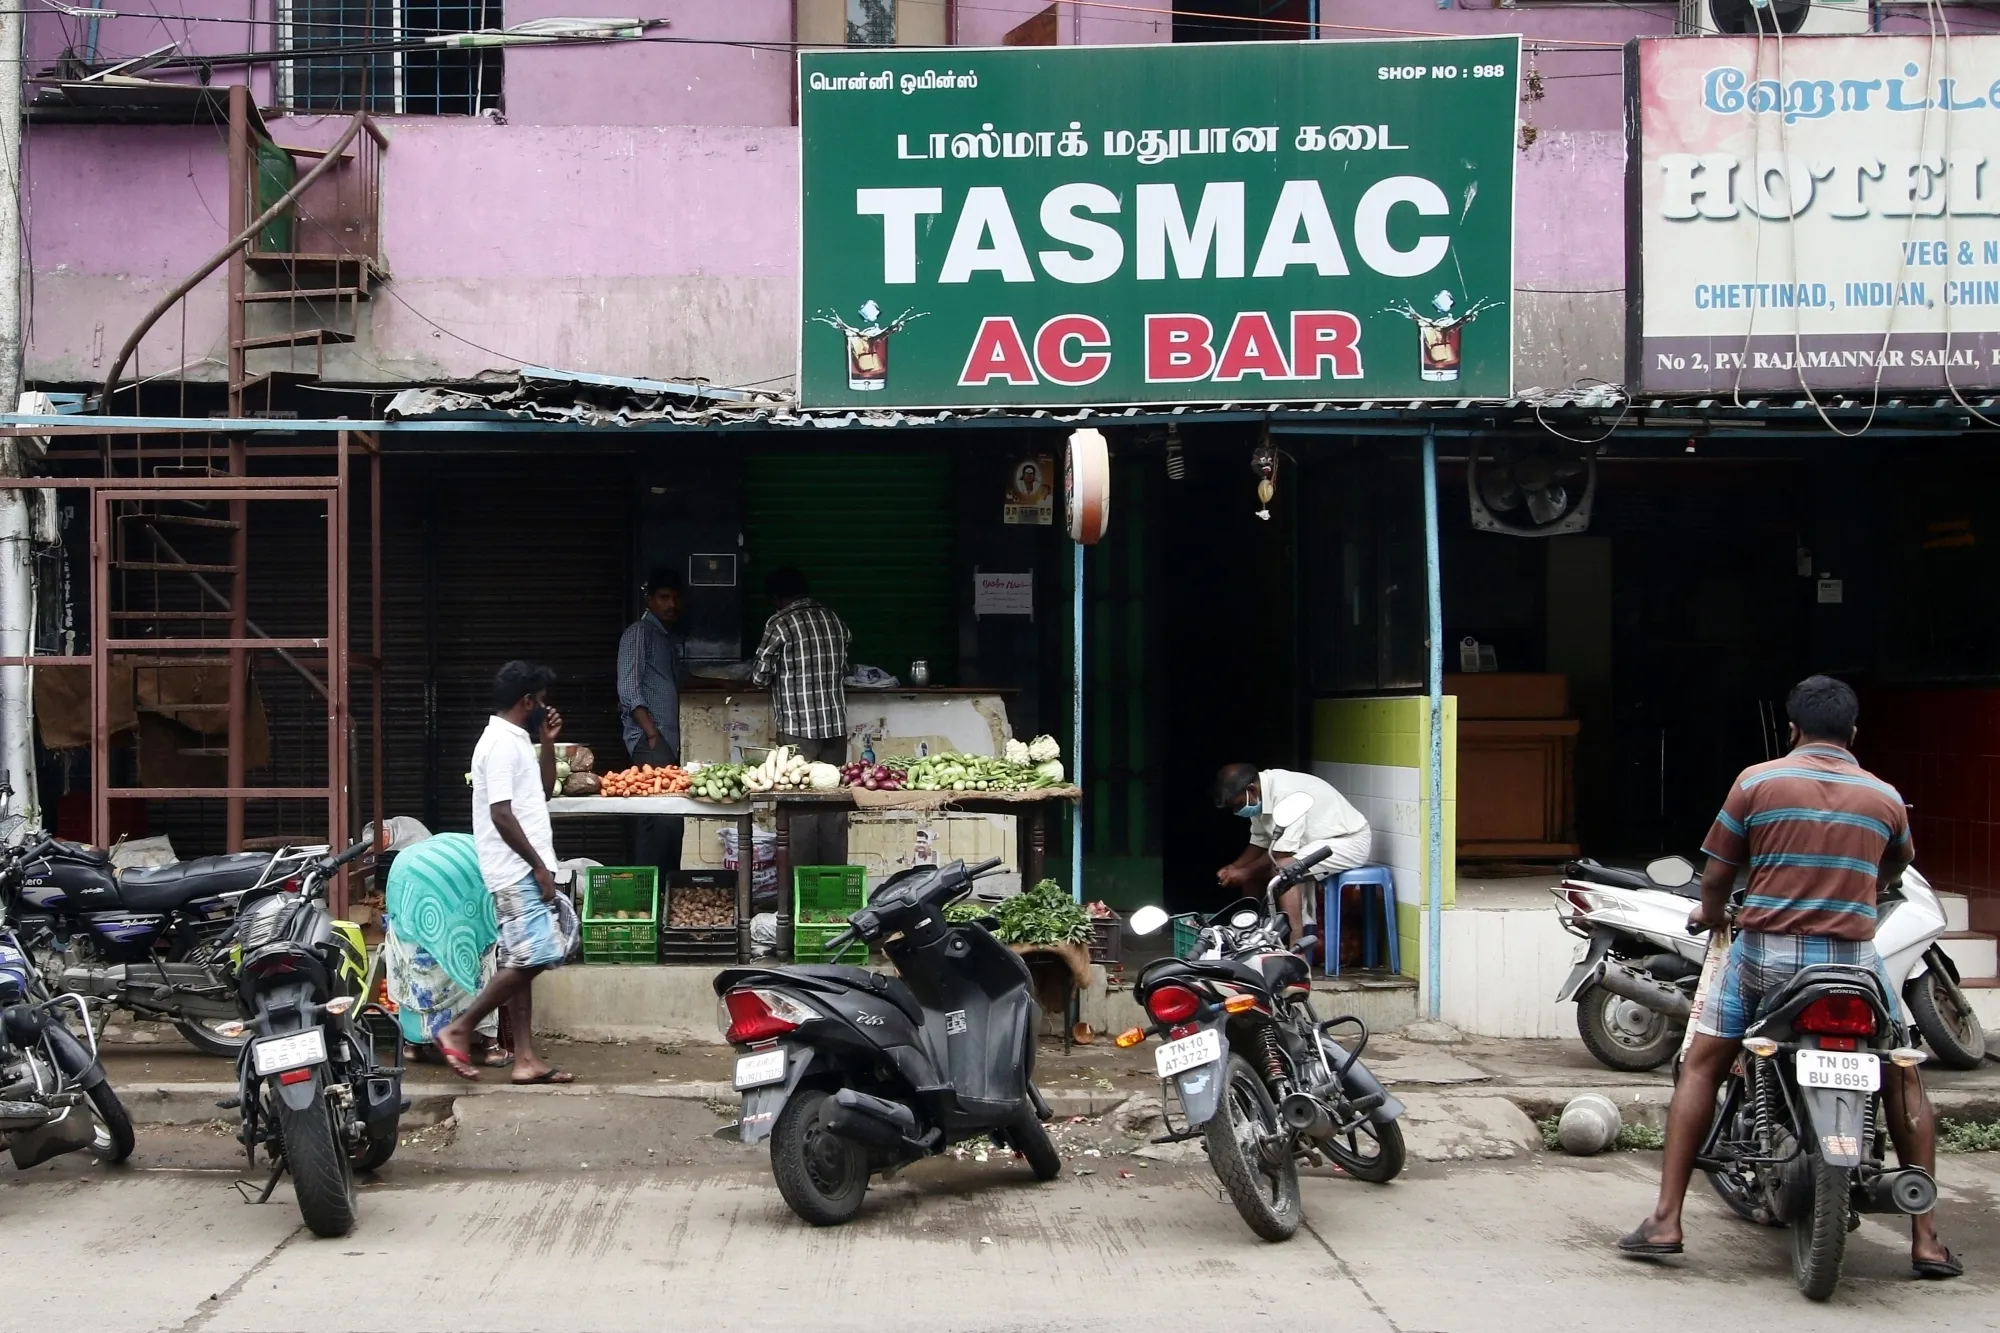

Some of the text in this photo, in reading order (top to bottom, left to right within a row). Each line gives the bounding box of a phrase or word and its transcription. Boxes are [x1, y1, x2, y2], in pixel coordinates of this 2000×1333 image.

[809, 69, 978, 95] பொன்னி ஒயின்ஸ்
[1377, 66, 1426, 80] SHOP
[1432, 65, 1458, 79] NO
[1473, 64, 1505, 78] 988
[898, 122, 1409, 164] டாஸ்மாக் மதுபான கடை
[1661, 152, 2000, 224] HOTEL
[857, 176, 1450, 284] TASMAC
[1902, 241, 1948, 266] VEG
[1957, 241, 1974, 266] &
[1695, 284, 1836, 312] CHETTINAD,
[957, 309, 1364, 387] AC BAR
[1657, 353, 1686, 370] No
[1691, 353, 1709, 374] 2,
[1715, 353, 1748, 369] P.V.
[1753, 350, 1906, 369] RAJAMANNAR
[1911, 349, 1980, 369] SALAI,
[1170, 1037, 1203, 1056] TN-10
[1165, 1048, 1209, 1072] AT-3727
[1817, 1055, 1859, 1070] TN 09
[1809, 1071, 1869, 1087] BU 8695
